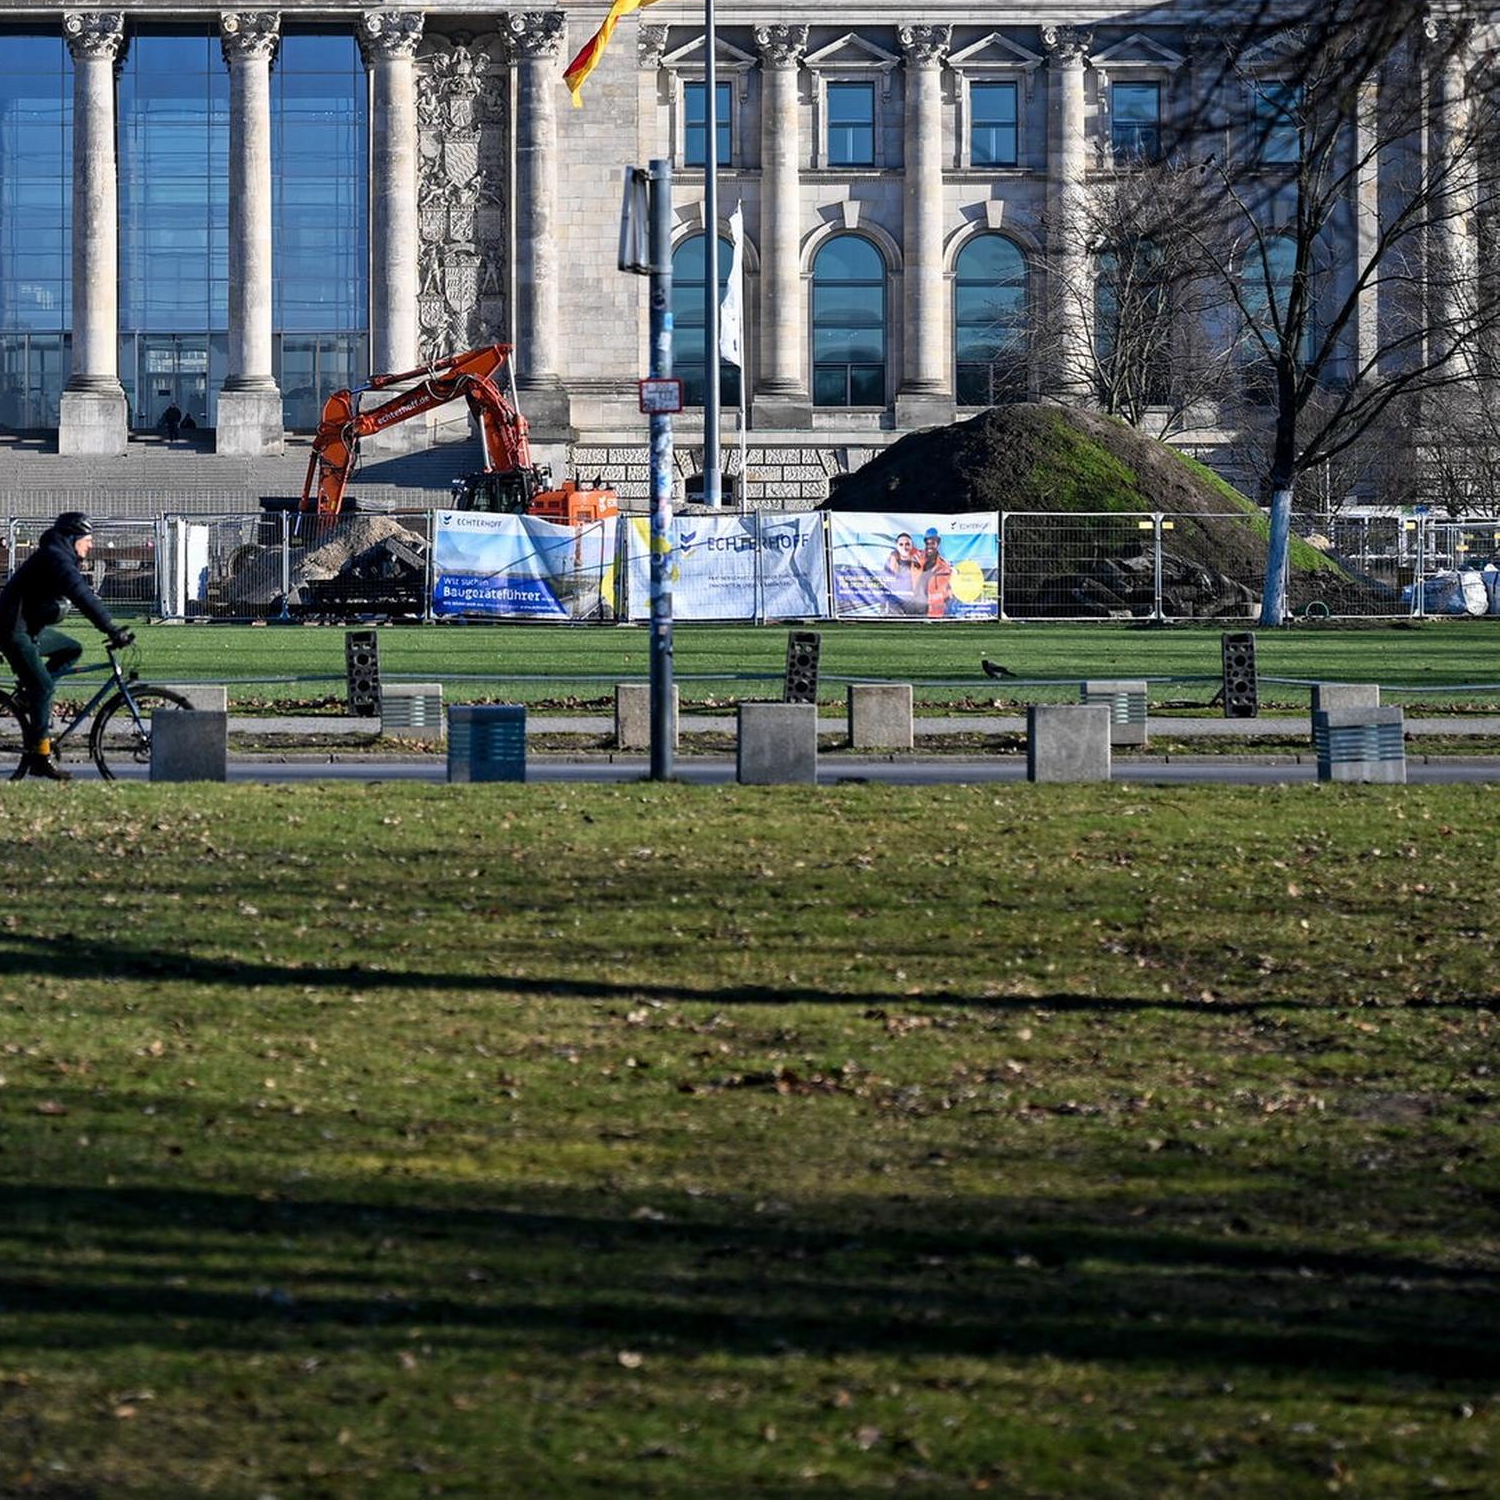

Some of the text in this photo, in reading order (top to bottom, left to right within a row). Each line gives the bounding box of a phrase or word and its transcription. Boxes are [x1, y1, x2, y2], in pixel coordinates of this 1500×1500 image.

[377, 395, 430, 424] echterhoff.de
[457, 518, 502, 528] ECHTERHOFF
[707, 533, 810, 551] ECHTERHOFF
[443, 577, 459, 585] Wir
[443, 586, 541, 601] Baugeräteführer
